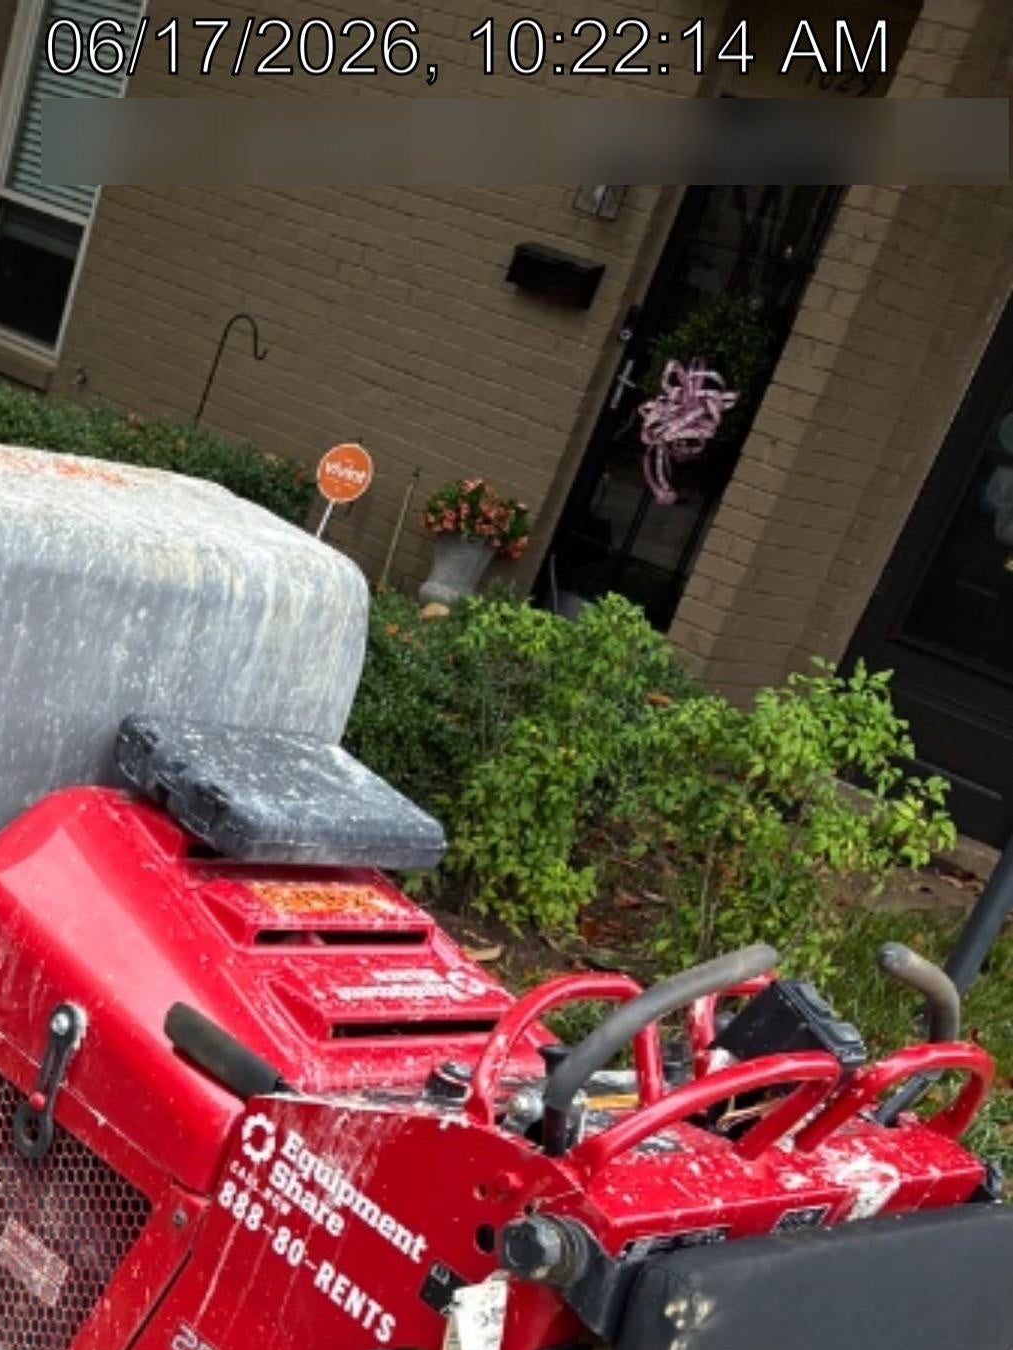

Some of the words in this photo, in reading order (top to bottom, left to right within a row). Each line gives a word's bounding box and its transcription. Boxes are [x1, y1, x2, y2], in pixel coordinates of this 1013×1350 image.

[218, 1180, 396, 1343] 888-80-RENTS
[269, 1159, 345, 1237] Share
[280, 1129, 428, 1264] Equipment
